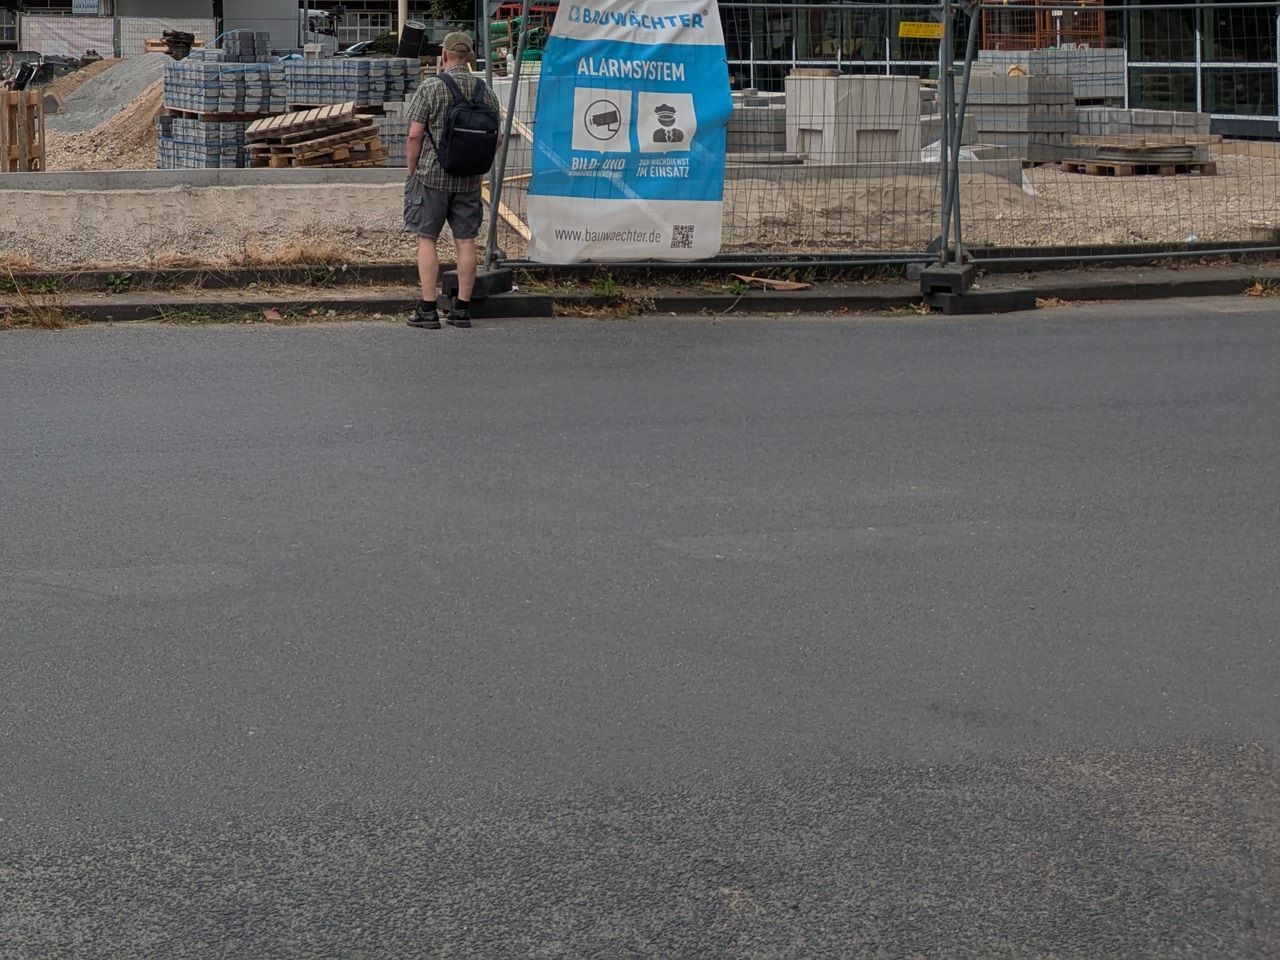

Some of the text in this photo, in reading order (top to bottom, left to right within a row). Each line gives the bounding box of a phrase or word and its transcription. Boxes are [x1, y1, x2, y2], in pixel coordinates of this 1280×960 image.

[582, 7, 705, 30] BAUWÄCHTER
[577, 56, 686, 82] ALARMSYSTEM
[649, 166, 689, 178] EINSATZ
[555, 226, 661, 244] www.bauwaechter.de
